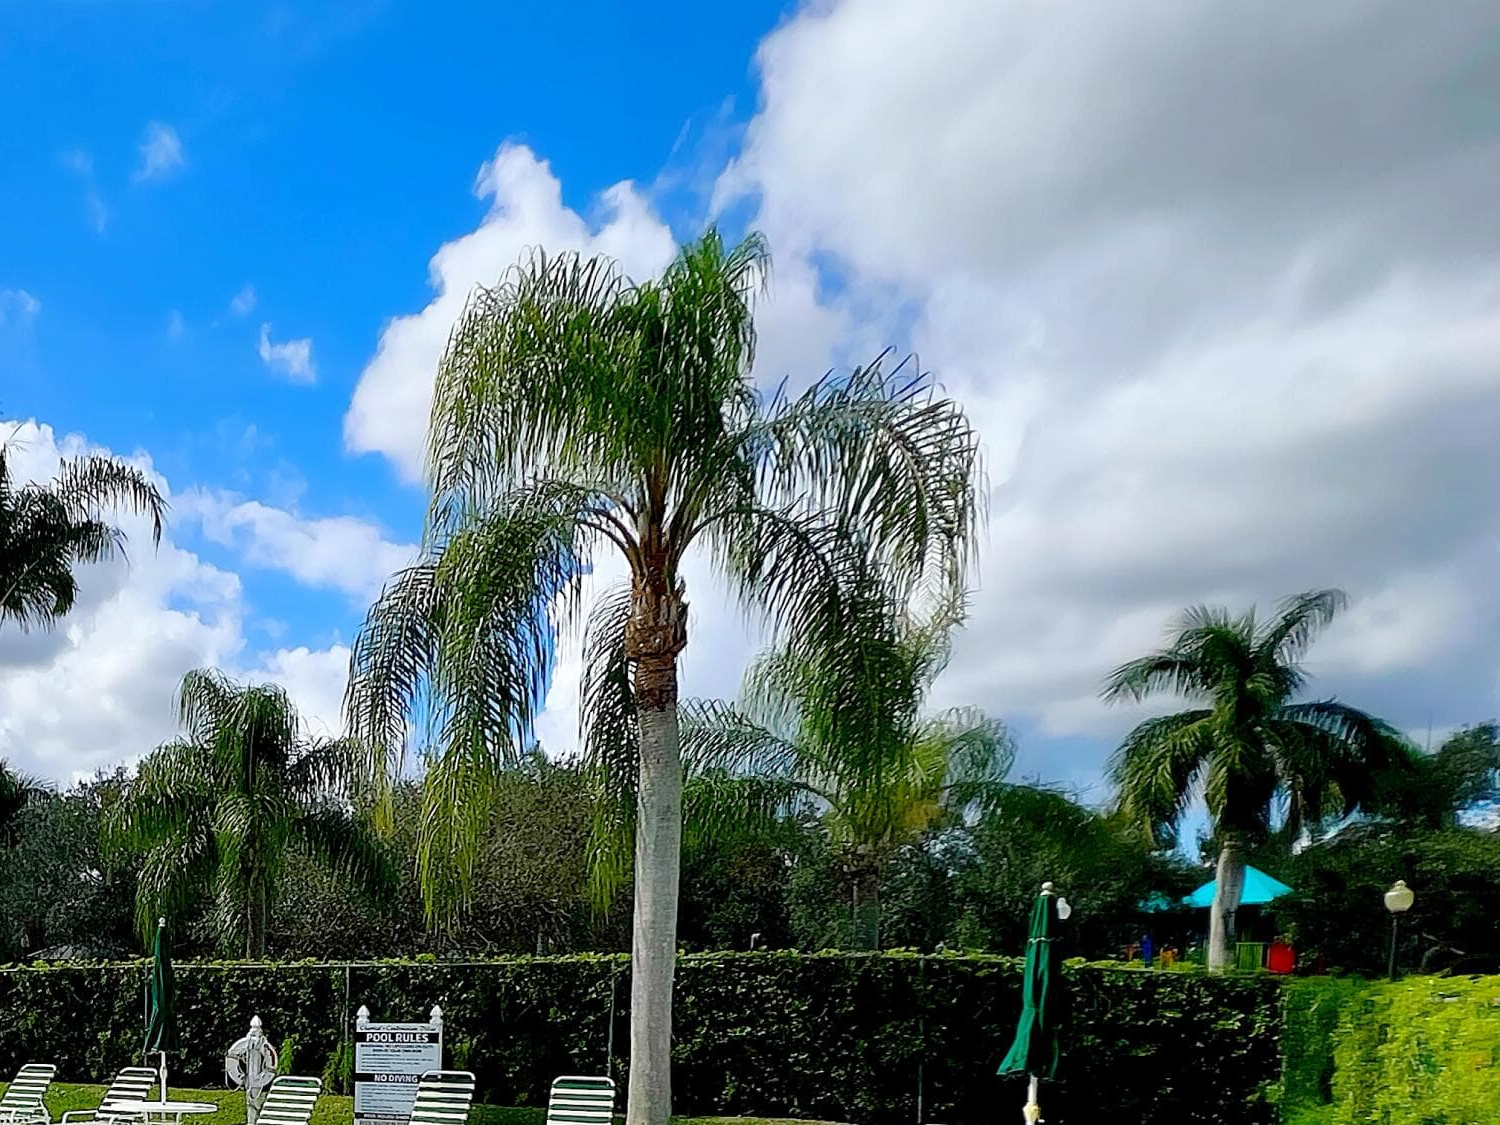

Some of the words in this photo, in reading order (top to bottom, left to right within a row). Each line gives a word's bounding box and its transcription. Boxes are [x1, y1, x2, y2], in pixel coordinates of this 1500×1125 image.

[366, 1033, 394, 1042] POOL
[395, 1033, 429, 1043] RULES
[374, 1074, 388, 1082] NO
[388, 1075, 418, 1083] DIVING
